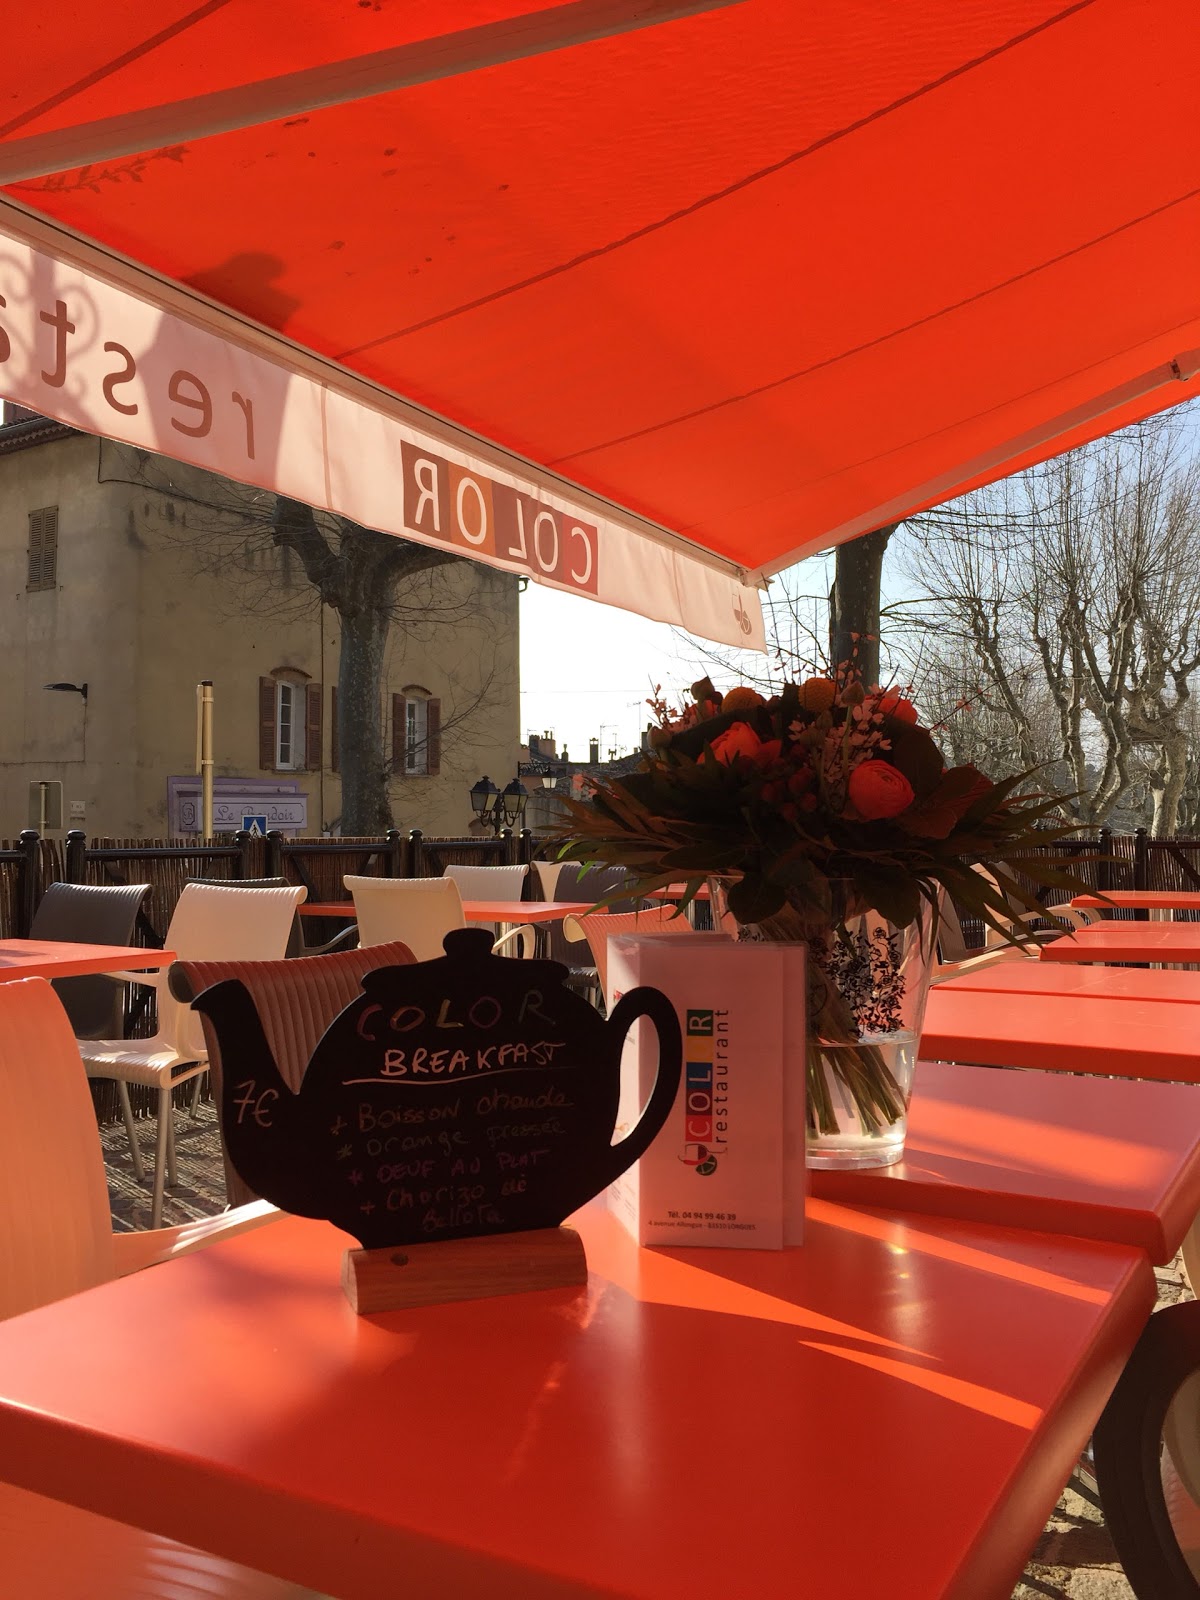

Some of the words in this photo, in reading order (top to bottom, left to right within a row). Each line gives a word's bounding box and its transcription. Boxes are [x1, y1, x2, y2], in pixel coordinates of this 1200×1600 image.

[215, 805, 234, 821] Le
[356, 989, 557, 1041] COLOR
[380, 1041, 566, 1076] BREAKFAST
[688, 1014, 713, 1138] COLOR
[715, 1010, 729, 1144] restaurant
[232, 1080, 279, 1127] 7€
[451, 1156, 481, 1176] AU
[496, 1149, 552, 1170] PLAT
[682, 1211, 692, 1219] 04
[693, 1212, 703, 1220] 94
[704, 1212, 714, 1220] 99
[715, 1213, 726, 1221] 46
[726, 1213, 737, 1221] 39
